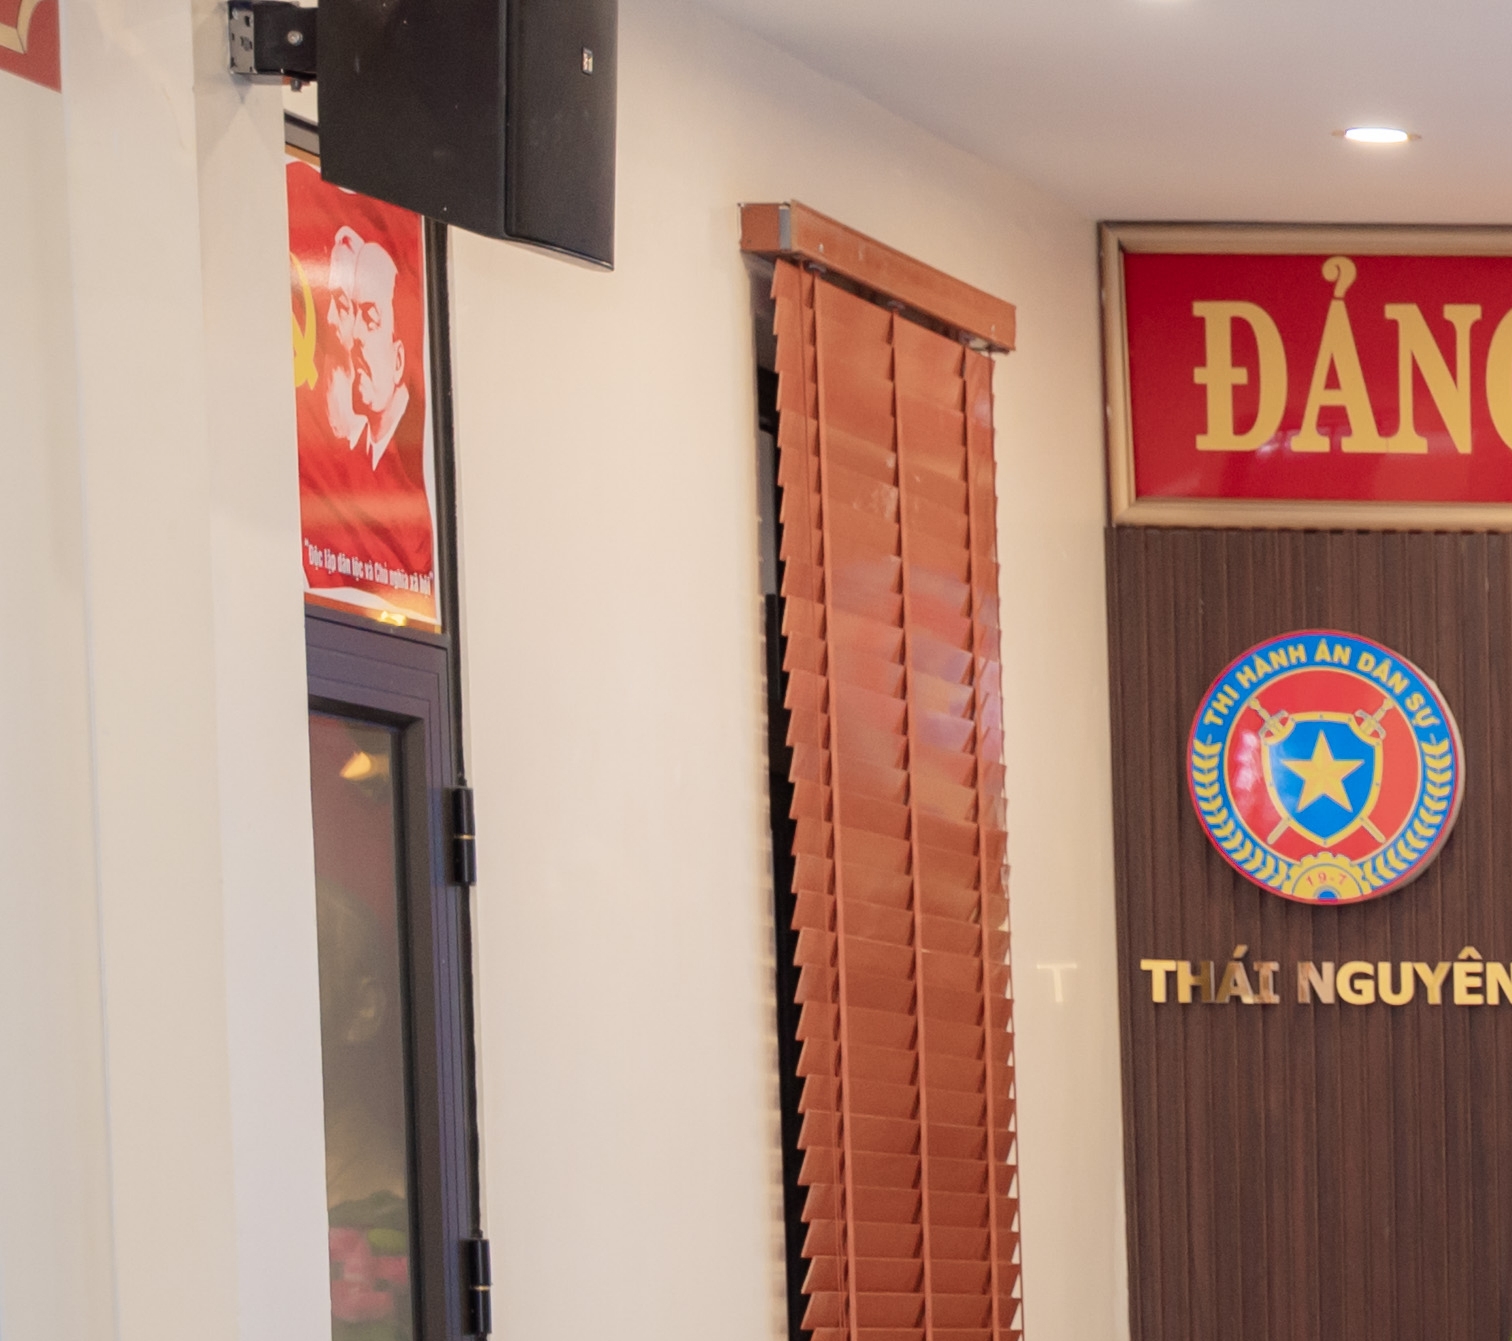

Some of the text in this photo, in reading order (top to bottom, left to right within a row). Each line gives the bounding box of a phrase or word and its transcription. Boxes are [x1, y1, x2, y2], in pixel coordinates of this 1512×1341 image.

[1203, 684, 1240, 727] THI
[1235, 643, 1308, 688] HÀNH
[1356, 651, 1409, 695] DÂN
[1140, 945, 1280, 1005] THÁI
